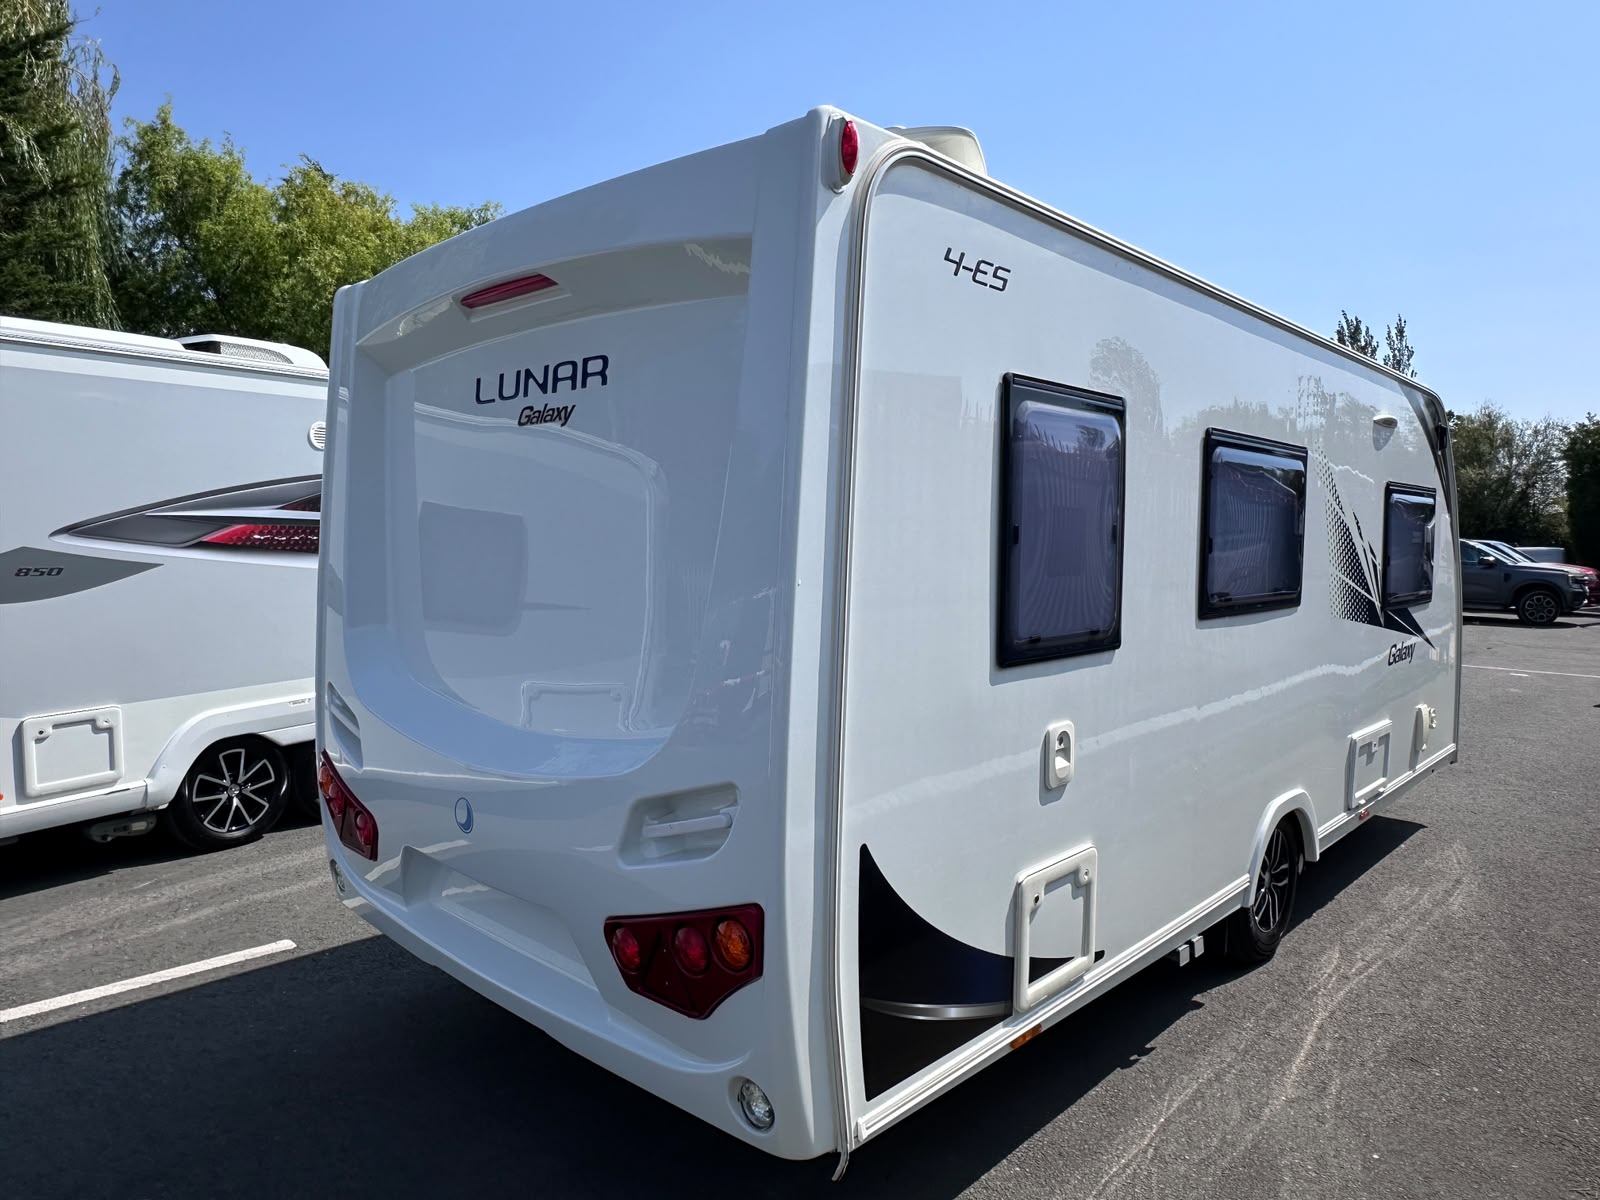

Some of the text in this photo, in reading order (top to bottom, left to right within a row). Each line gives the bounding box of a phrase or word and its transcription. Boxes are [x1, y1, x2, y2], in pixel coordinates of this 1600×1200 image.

[943, 246, 1012, 292] 4-ES
[475, 354, 609, 405] LUNAR
[517, 402, 577, 428] Galaxy
[14, 566, 65, 577] 850
[1387, 640, 1417, 667] Galaxy
